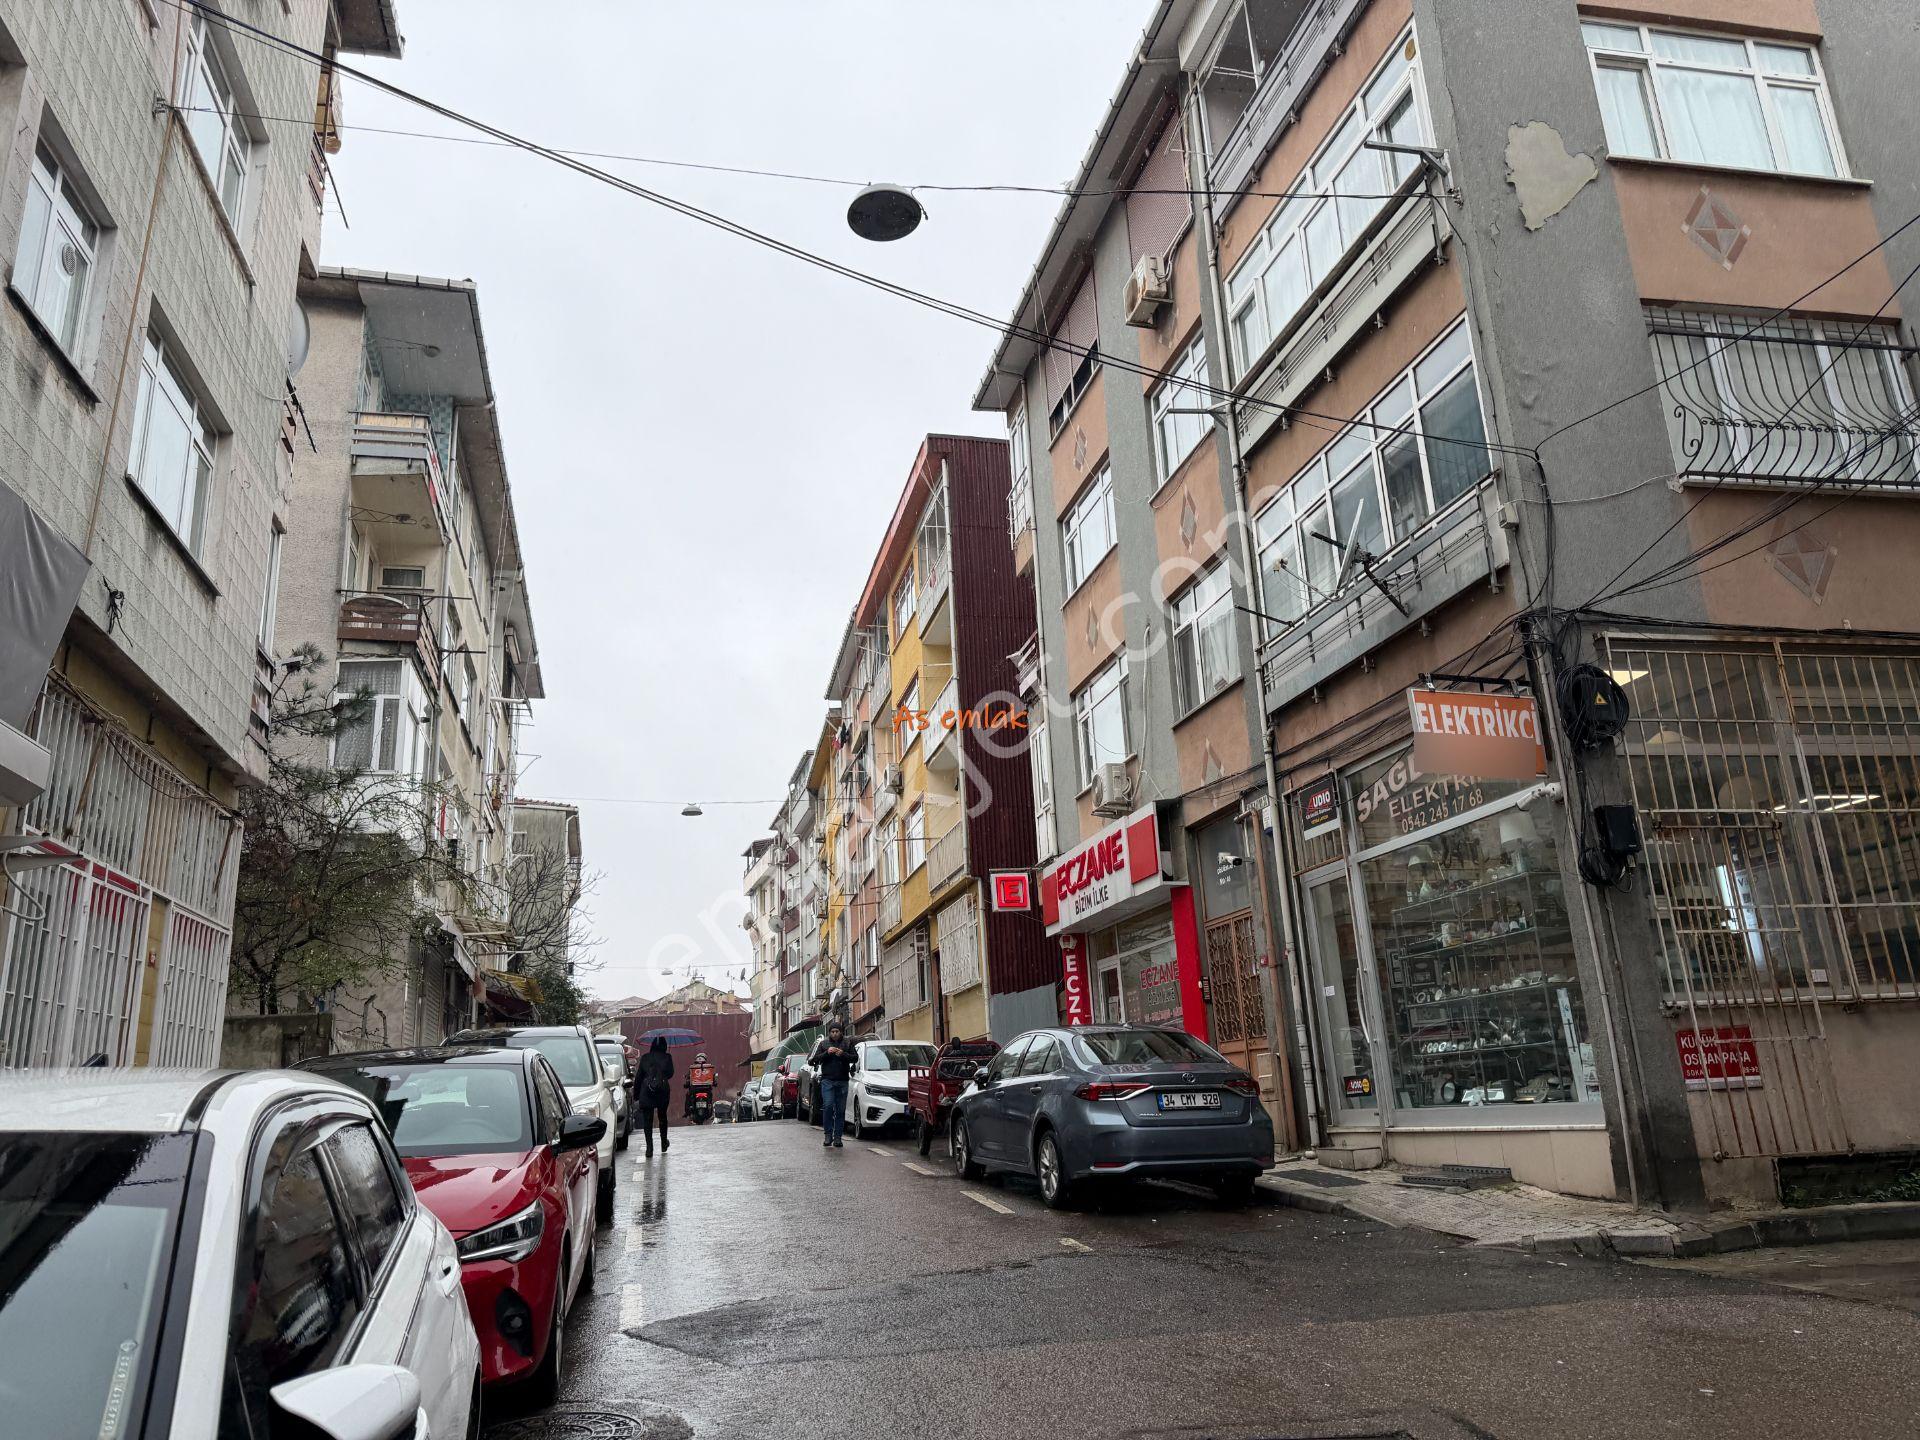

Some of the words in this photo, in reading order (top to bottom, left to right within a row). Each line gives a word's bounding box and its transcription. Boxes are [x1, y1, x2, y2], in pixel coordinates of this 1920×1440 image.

[1389, 775, 1482, 818] ELEKTR
[1402, 811, 1428, 833] 0542
[1428, 801, 1449, 823] 245
[1452, 794, 1465, 813] 17
[1469, 788, 1483, 807] 68
[1057, 829, 1124, 900] ECZANE
[1075, 892, 1092, 915] BİZİM
[1092, 885, 1109, 906] İLKE
[1140, 960, 1180, 989] ECZANE
[1681, 1034, 1717, 1049] KÜÜK
[1686, 1068, 1711, 1077] SOKAI
[1164, 1094, 1176, 1106] 34
[1180, 1094, 1197, 1106] CMY
[1202, 1093, 1219, 1105] 928
